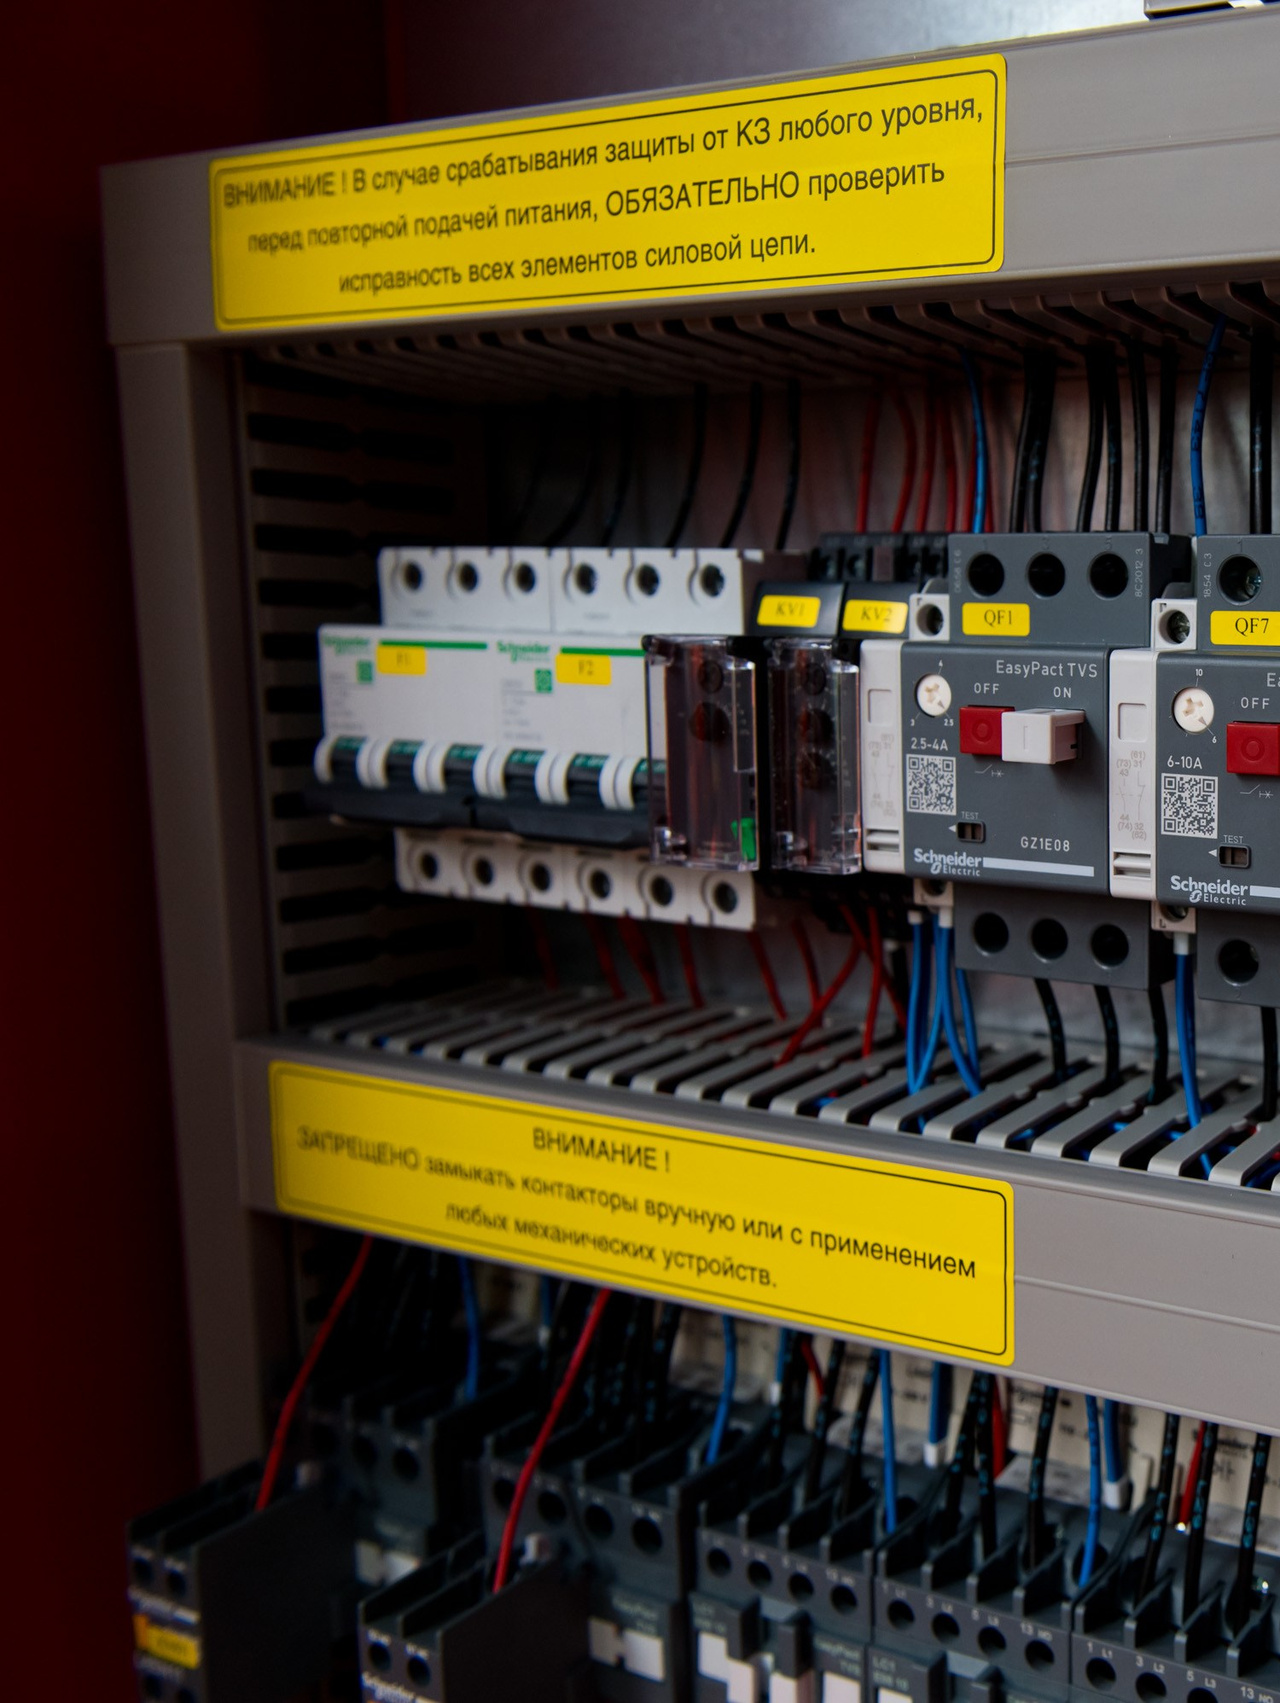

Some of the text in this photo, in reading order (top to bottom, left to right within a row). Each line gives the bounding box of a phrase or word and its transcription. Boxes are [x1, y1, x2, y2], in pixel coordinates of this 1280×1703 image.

[224, 170, 336, 207] ВНИМАНИЕ
[353, 166, 366, 192] В
[372, 161, 439, 196] случае
[447, 143, 597, 184] срабатывания
[605, 132, 696, 166] защиты
[702, 128, 726, 150] от
[736, 117, 771, 145] КЗ
[779, 108, 872, 143] любого
[881, 94, 984, 136] уровня,
[249, 157, 945, 254] перед повторной подачей питания, ОБЯЗАТЕЛЬНО проверить
[339, 231, 817, 294] исправность всех элементов силовой цепи.
[861, 606, 892, 622] KV2
[983, 610, 1013, 627] QF1
[1235, 618, 1270, 637] QF7
[996, 660, 1098, 678] EasyPact TVS
[1195, 669, 1203, 677] 10
[974, 683, 1000, 695] OFF
[1053, 687, 1072, 699] ON
[1240, 698, 1270, 709] OFF
[911, 738, 949, 751] 2.5-4A
[1167, 756, 1203, 770] 6-10A
[961, 812, 979, 820] TEST
[1021, 837, 1071, 852] GZ1E08
[1223, 835, 1243, 844] TEST
[913, 848, 982, 868] Schneider
[943, 865, 981, 877] Electric
[1170, 875, 1249, 897] Schneider
[1204, 895, 1247, 906] Electric
[533, 1126, 657, 1172] ВНИМАНИЕ
[297, 1126, 976, 1279] ЗАПРЕЩЕНО замыкать контакторы вручную или с применением
[446, 1200, 777, 1291] любых механических устройств.
[1240, 1686, 1255, 1699] 13
